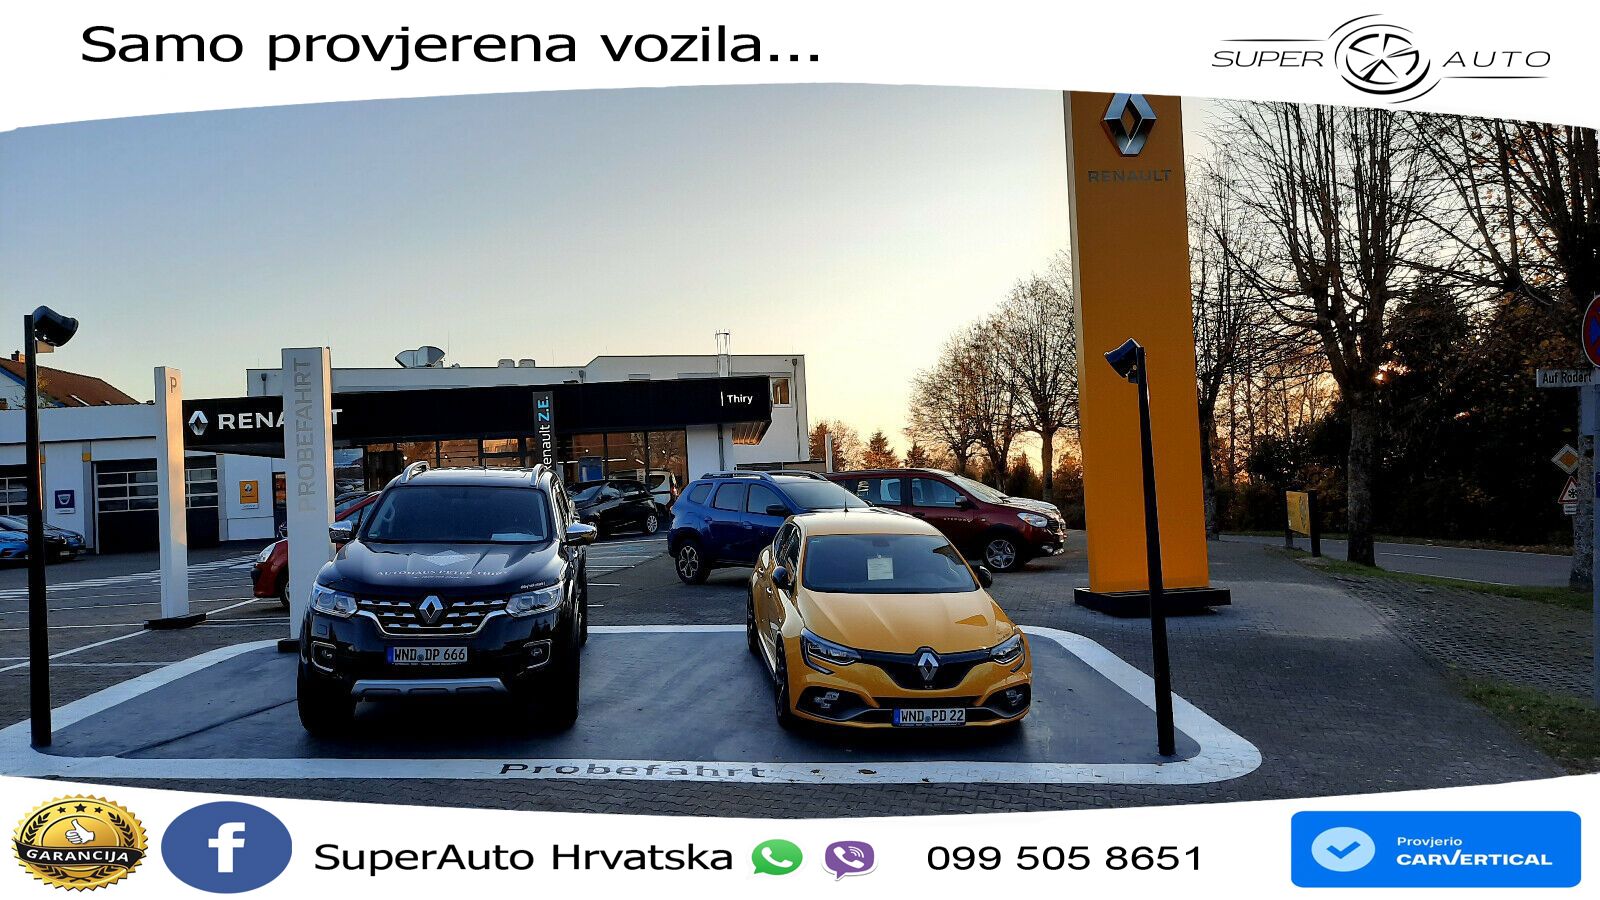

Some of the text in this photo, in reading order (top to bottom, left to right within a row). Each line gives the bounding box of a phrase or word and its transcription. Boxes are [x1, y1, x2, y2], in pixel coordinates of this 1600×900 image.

[1087, 169, 1171, 182] RENAULT
[1542, 371, 1558, 384] Auf
[169, 376, 177, 393] P
[726, 394, 753, 404] Thiry
[394, 648, 465, 660] WND DP 666
[901, 709, 964, 722] WND PD 22
[499, 763, 767, 778] Probefahrt
